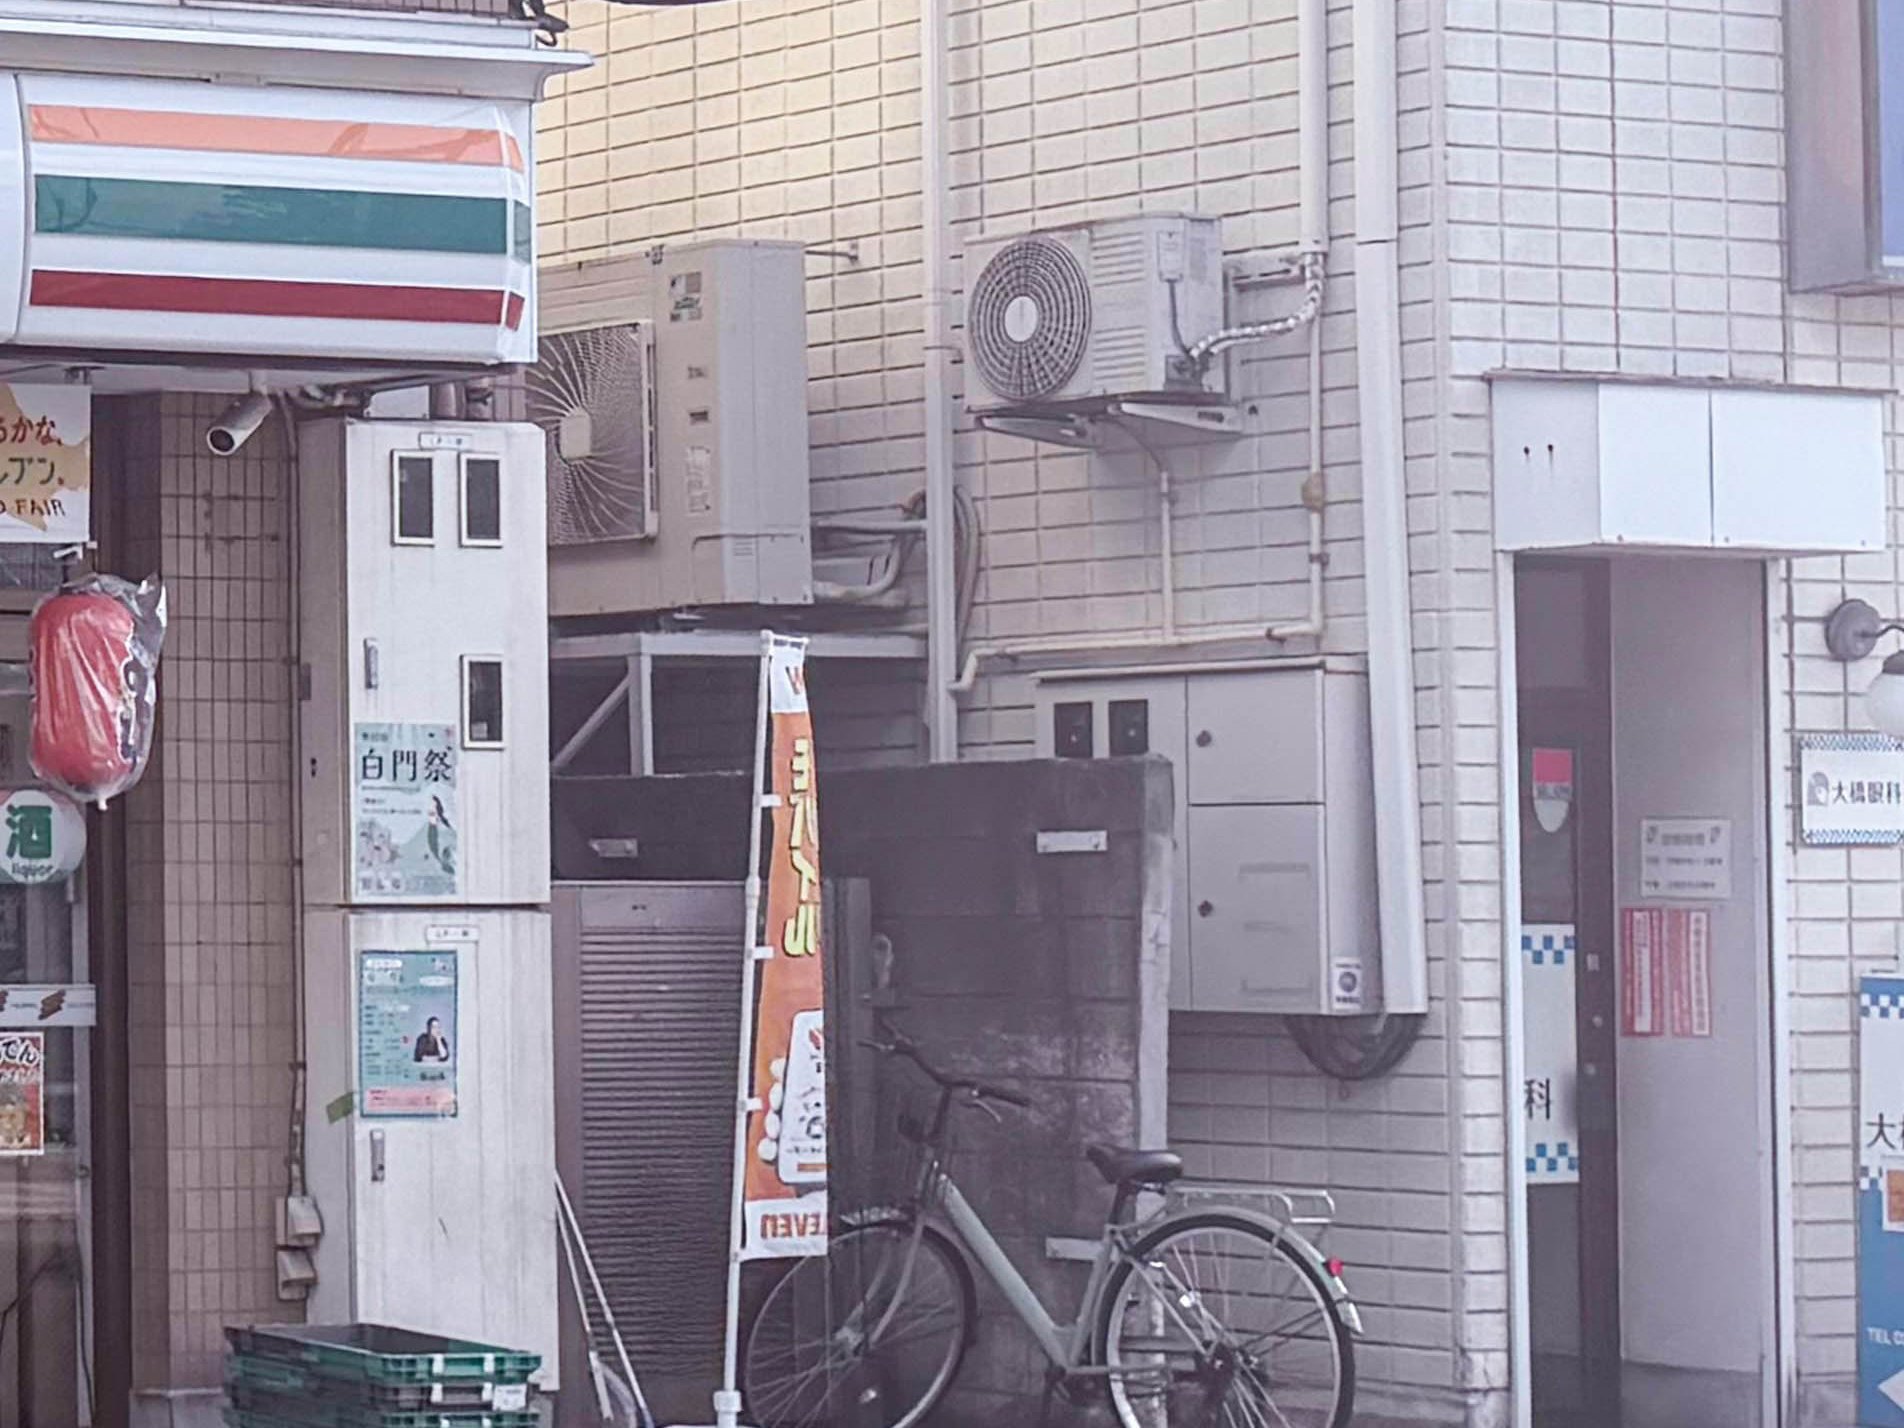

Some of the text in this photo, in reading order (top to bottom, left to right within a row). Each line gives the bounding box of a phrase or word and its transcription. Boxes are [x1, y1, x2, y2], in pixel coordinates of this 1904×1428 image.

[16, 498, 67, 519] FAIR
[360, 747, 454, 783] 白門祭
[5, 804, 53, 859] 酒
[1523, 1077, 1552, 1121] 科
[1866, 1327, 1893, 1346] TEL
